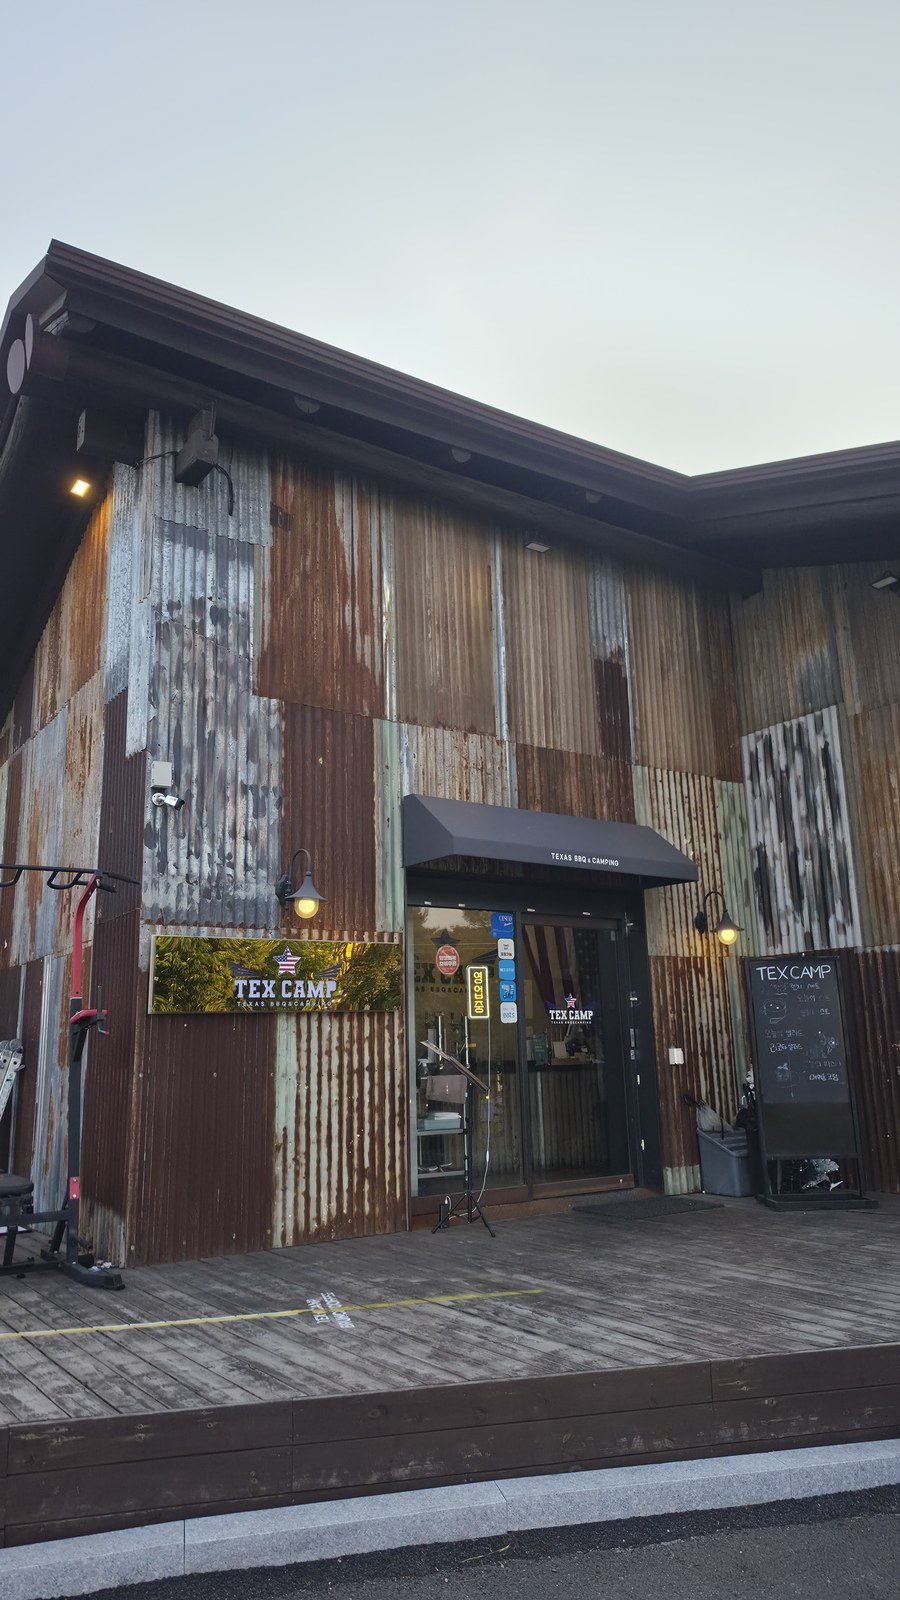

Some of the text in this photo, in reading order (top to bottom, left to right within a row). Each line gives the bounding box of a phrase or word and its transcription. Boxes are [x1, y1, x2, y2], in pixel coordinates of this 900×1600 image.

[551, 852, 572, 861] TEXAS
[574, 855, 586, 863] BBQ
[592, 857, 619, 866] CAMPING
[234, 980, 337, 998] TEX CAMP
[474, 972, 485, 1014] 영업중
[549, 1010, 593, 1020] TEX CAMP
